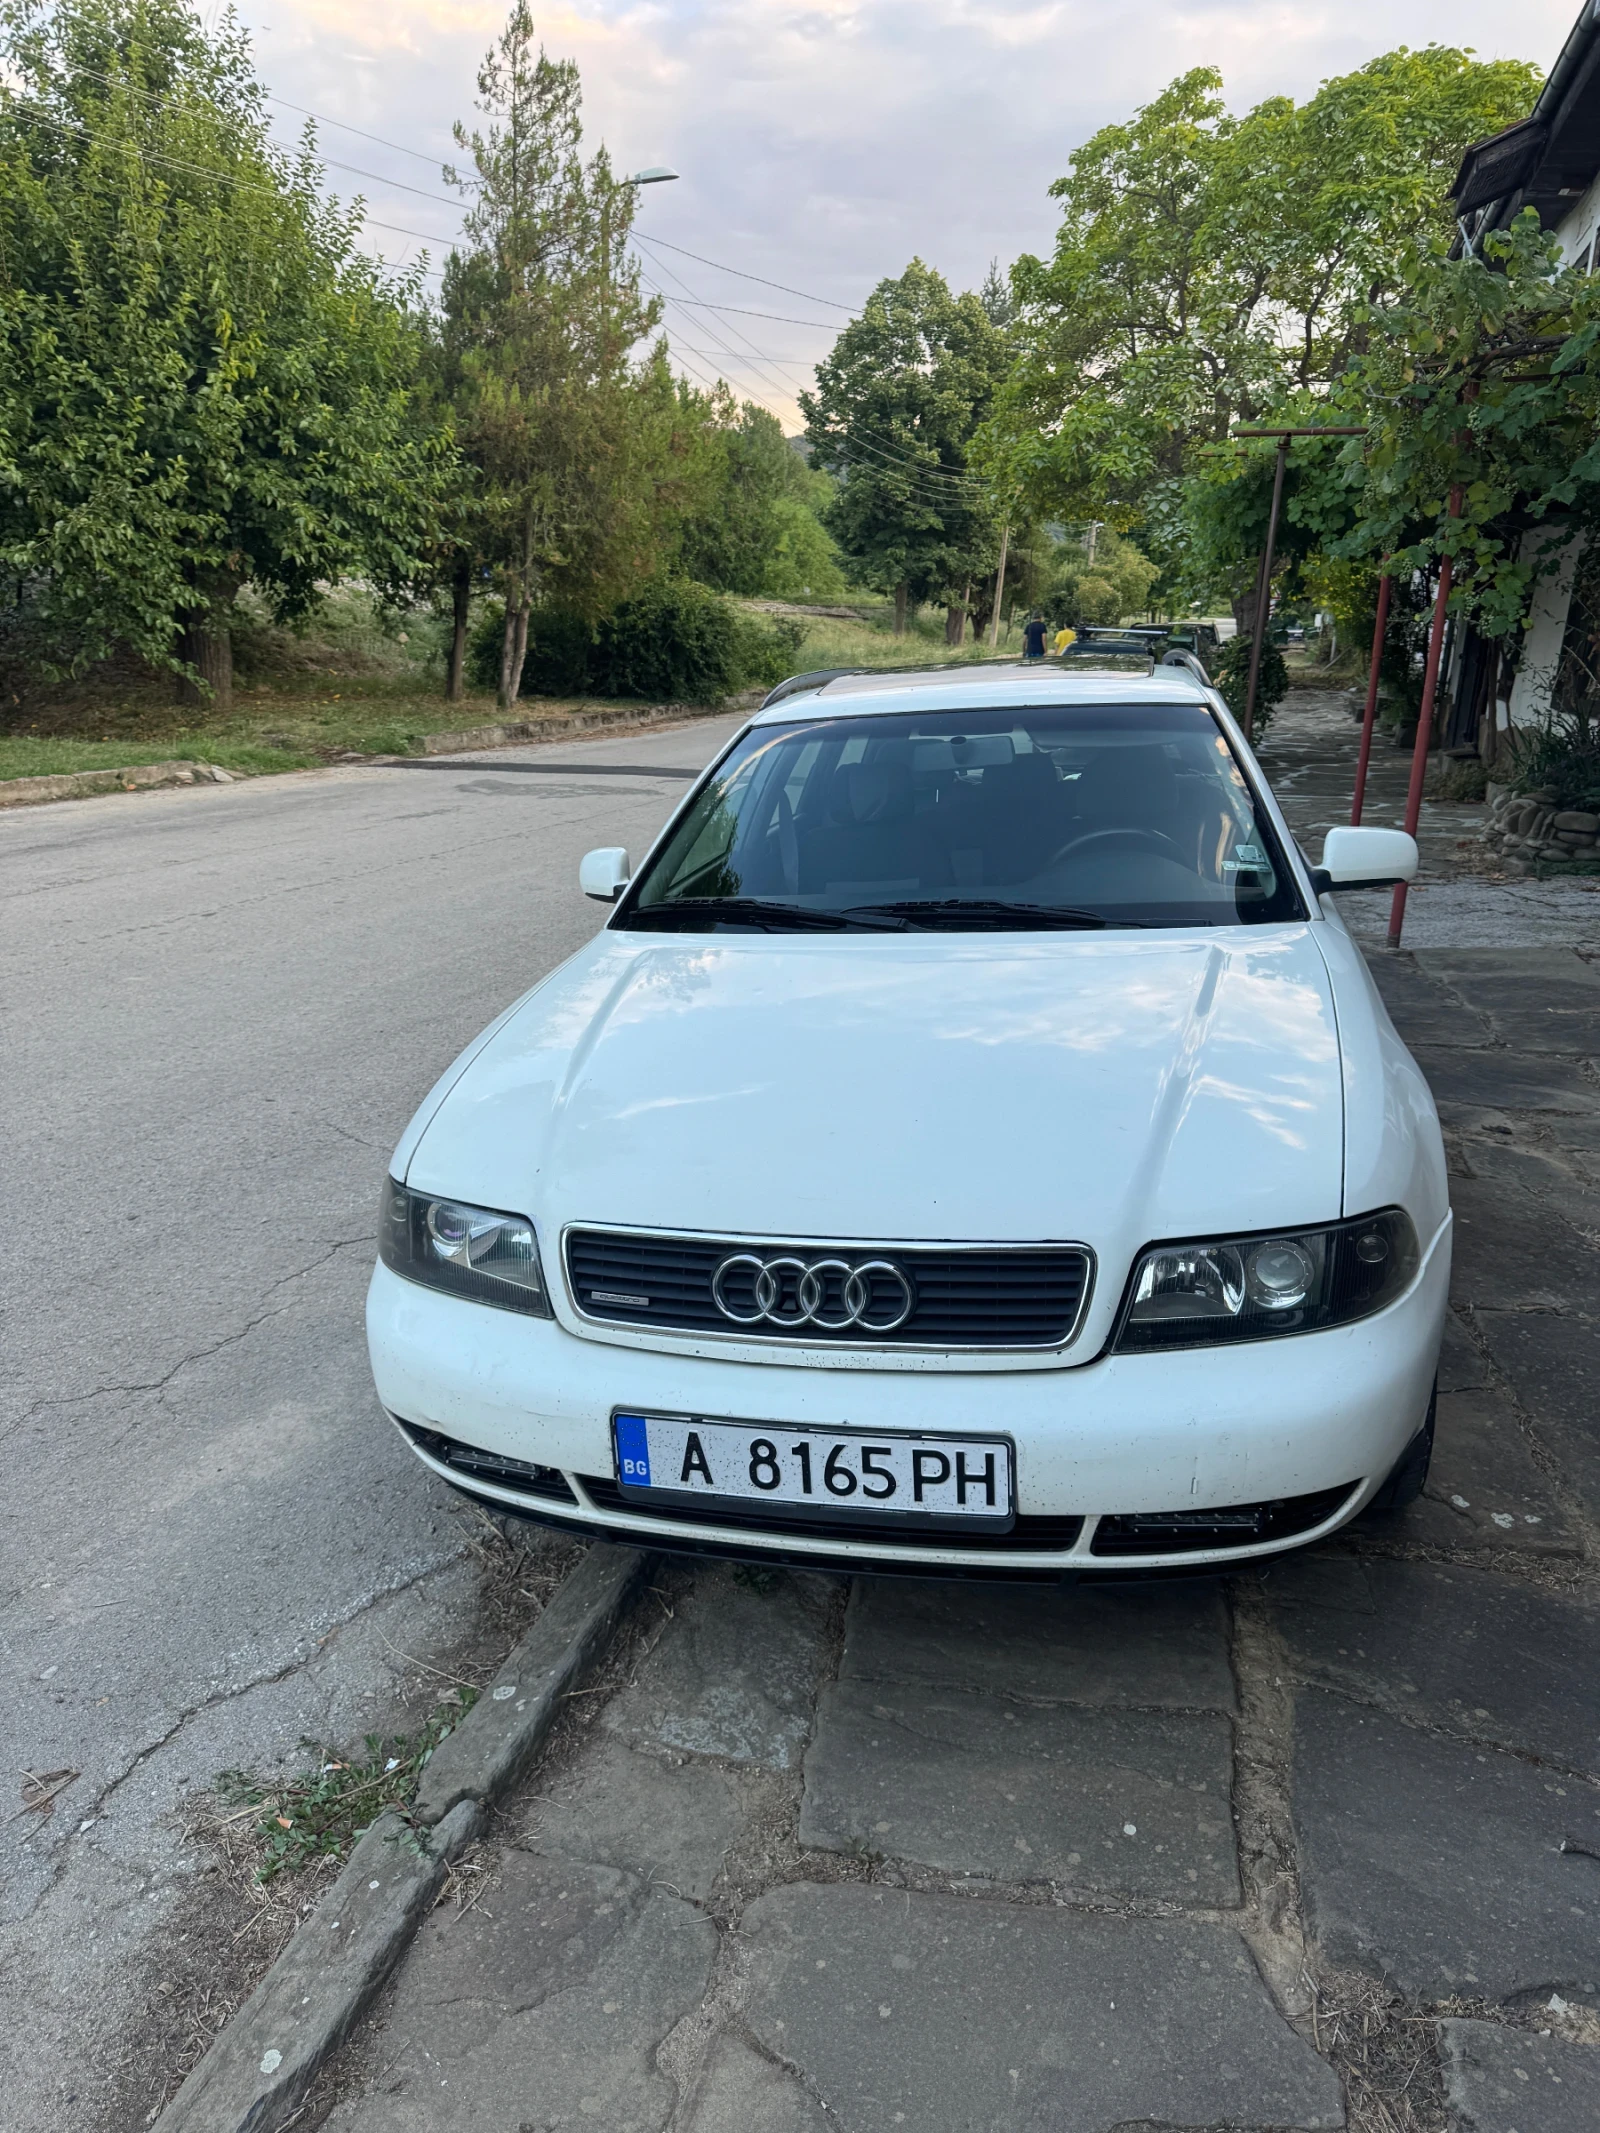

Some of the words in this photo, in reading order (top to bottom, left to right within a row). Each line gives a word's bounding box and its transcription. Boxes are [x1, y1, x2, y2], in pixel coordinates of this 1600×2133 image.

[624, 1458, 647, 1476] BG
[680, 1431, 714, 1484] A
[748, 1438, 897, 1499] 8165
[912, 1448, 995, 1506] PH
